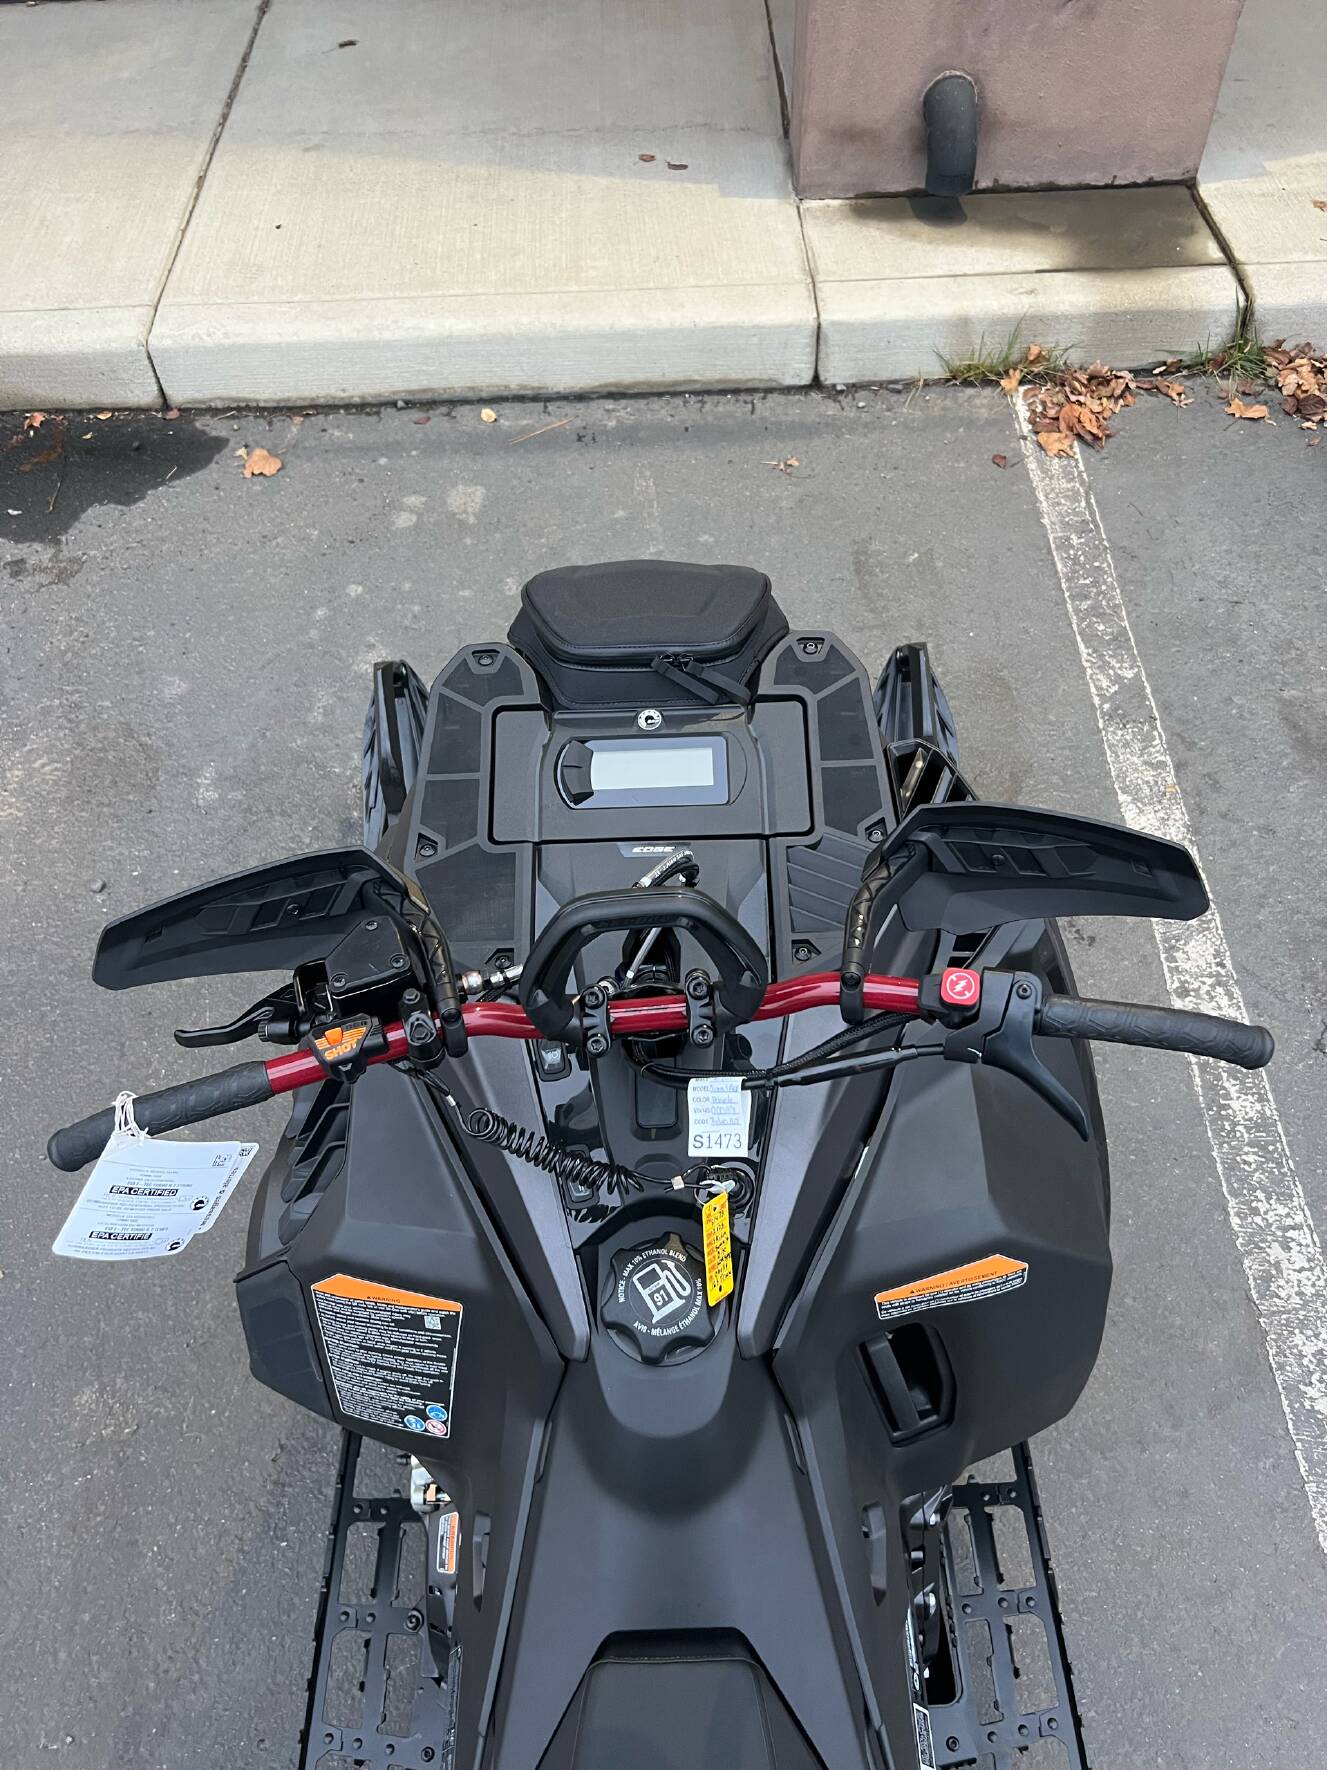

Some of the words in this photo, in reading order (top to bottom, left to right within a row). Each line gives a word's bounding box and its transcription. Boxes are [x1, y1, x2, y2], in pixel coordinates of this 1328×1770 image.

[324, 1039, 358, 1061] SHOT
[692, 1133, 742, 1149] S1473
[111, 1185, 131, 1194] EPA
[130, 1187, 177, 1196] CERTIFIED
[91, 1231, 109, 1240] EPA
[632, 1254, 643, 1265] 10%
[669, 1249, 686, 1263] BLEND
[622, 1262, 634, 1277] MAX
[618, 1280, 627, 1303] NOTICE
[653, 1289, 668, 1306] 91
[633, 1321, 647, 1333] AVIS
[695, 1291, 703, 1308] MAX
